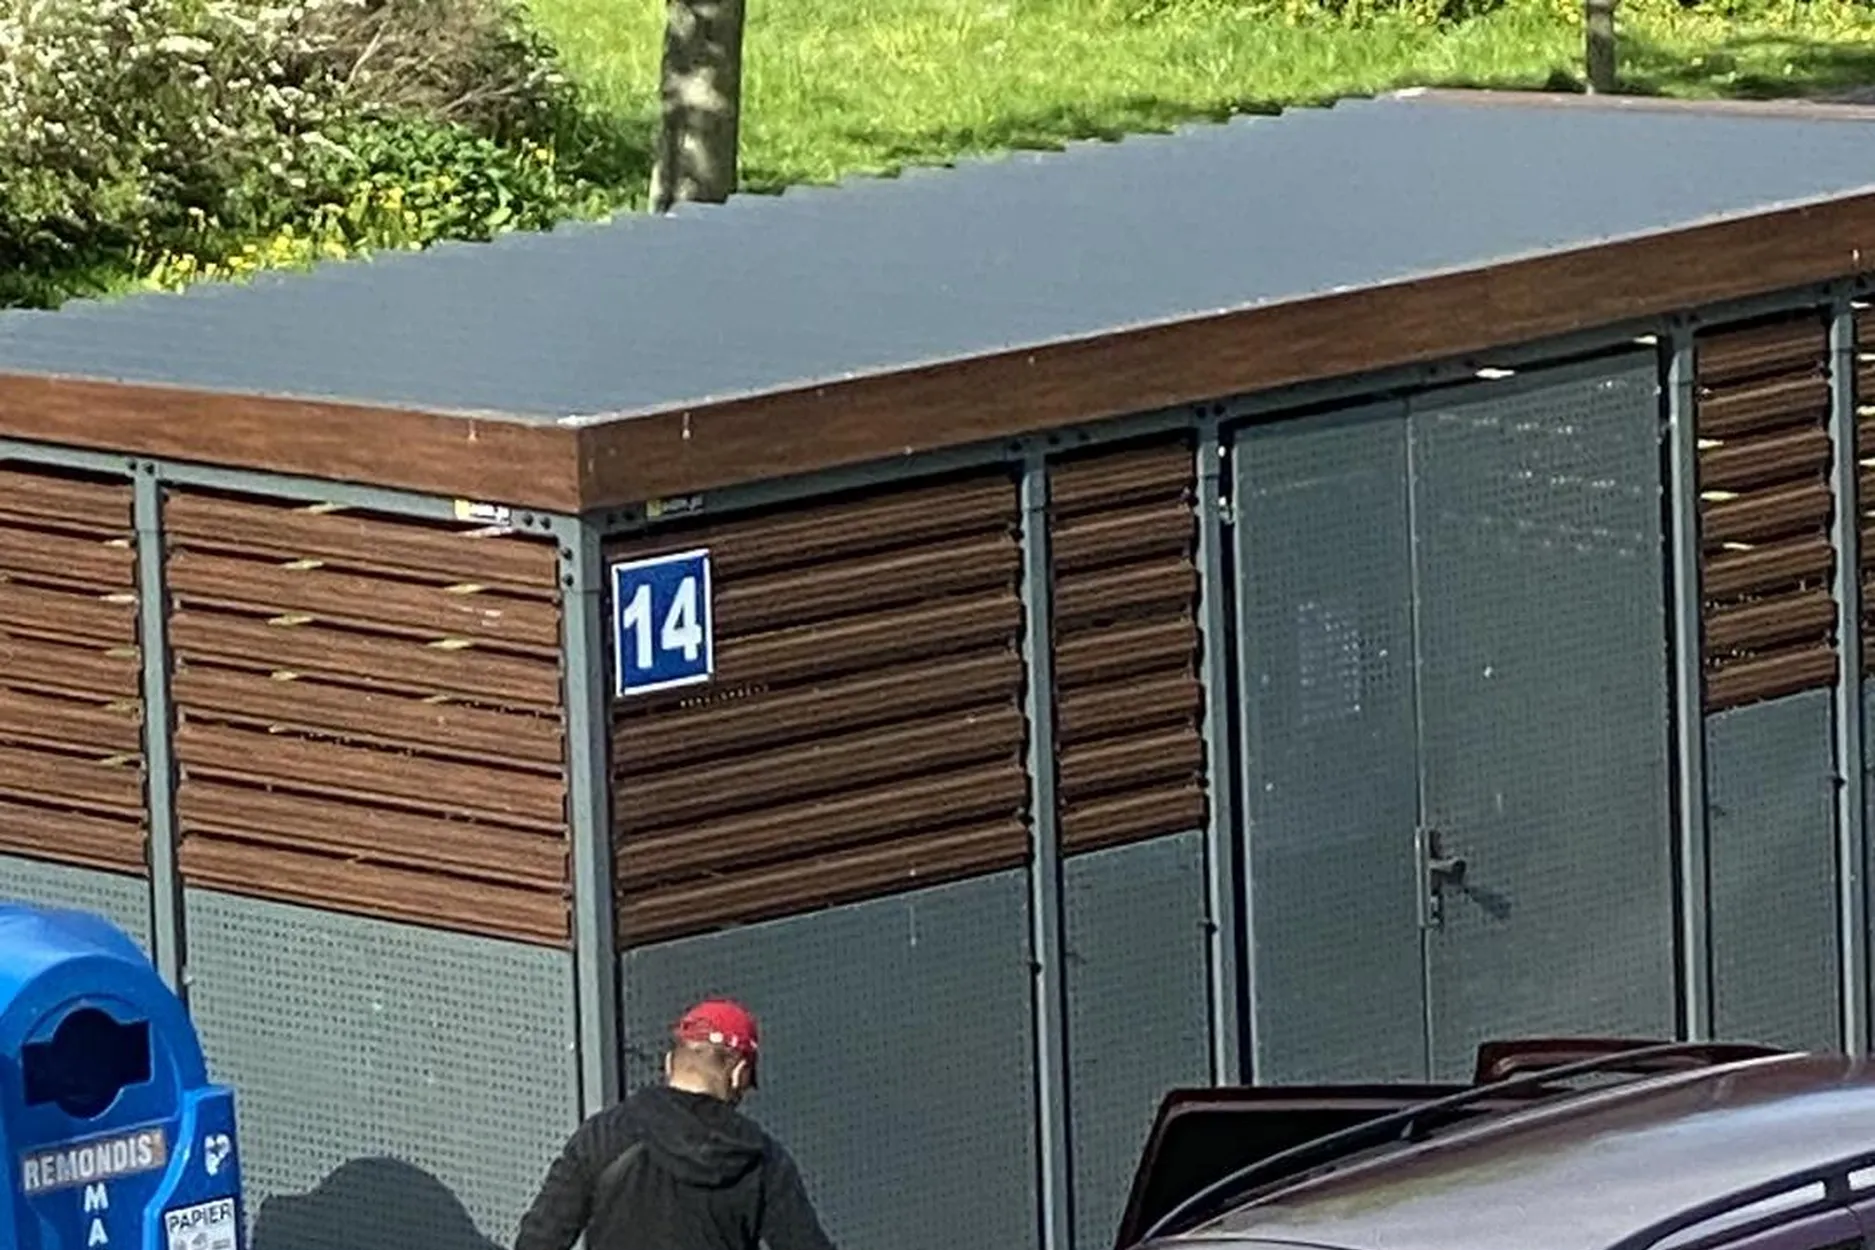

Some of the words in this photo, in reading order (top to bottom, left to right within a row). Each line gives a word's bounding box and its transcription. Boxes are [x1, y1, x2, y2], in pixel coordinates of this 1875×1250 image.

[623, 575, 703, 669] 14
[24, 1133, 153, 1191] REMONDIS
[169, 1203, 233, 1233] PAPIER
